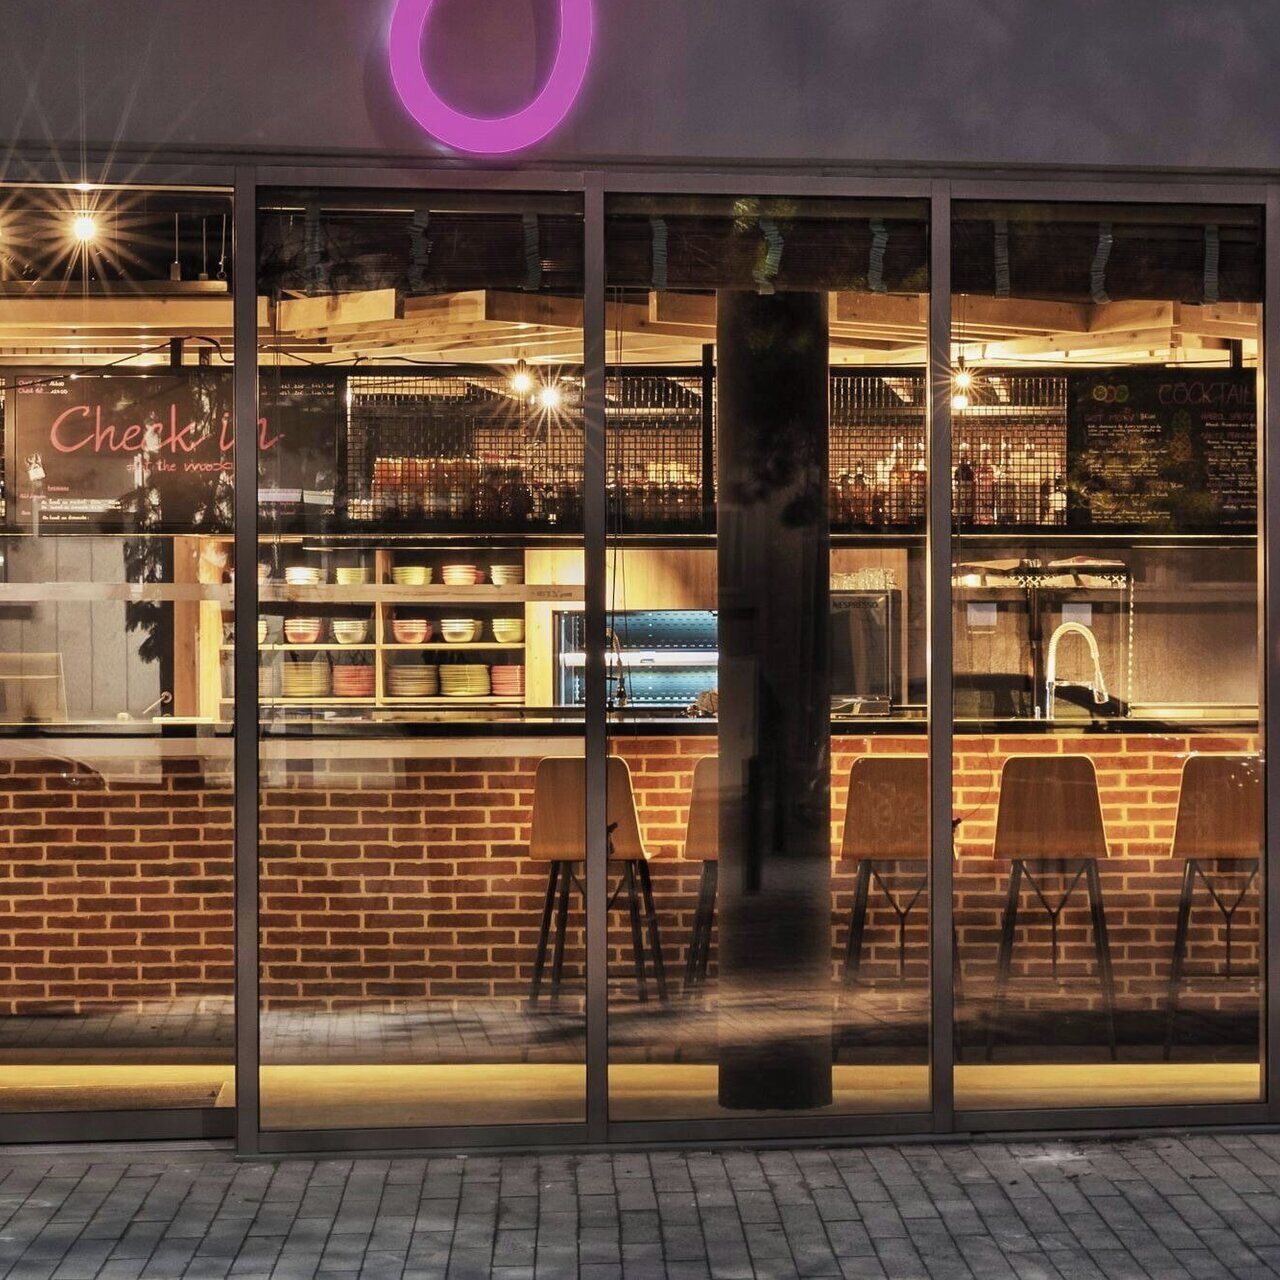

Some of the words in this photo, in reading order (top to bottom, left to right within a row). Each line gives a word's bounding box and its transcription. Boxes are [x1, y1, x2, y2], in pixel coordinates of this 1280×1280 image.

[51, 403, 211, 453] Check
[156, 458, 177, 472] the
[184, 462, 233, 472] mox
[832, 600, 879, 609] NESPRESSO
